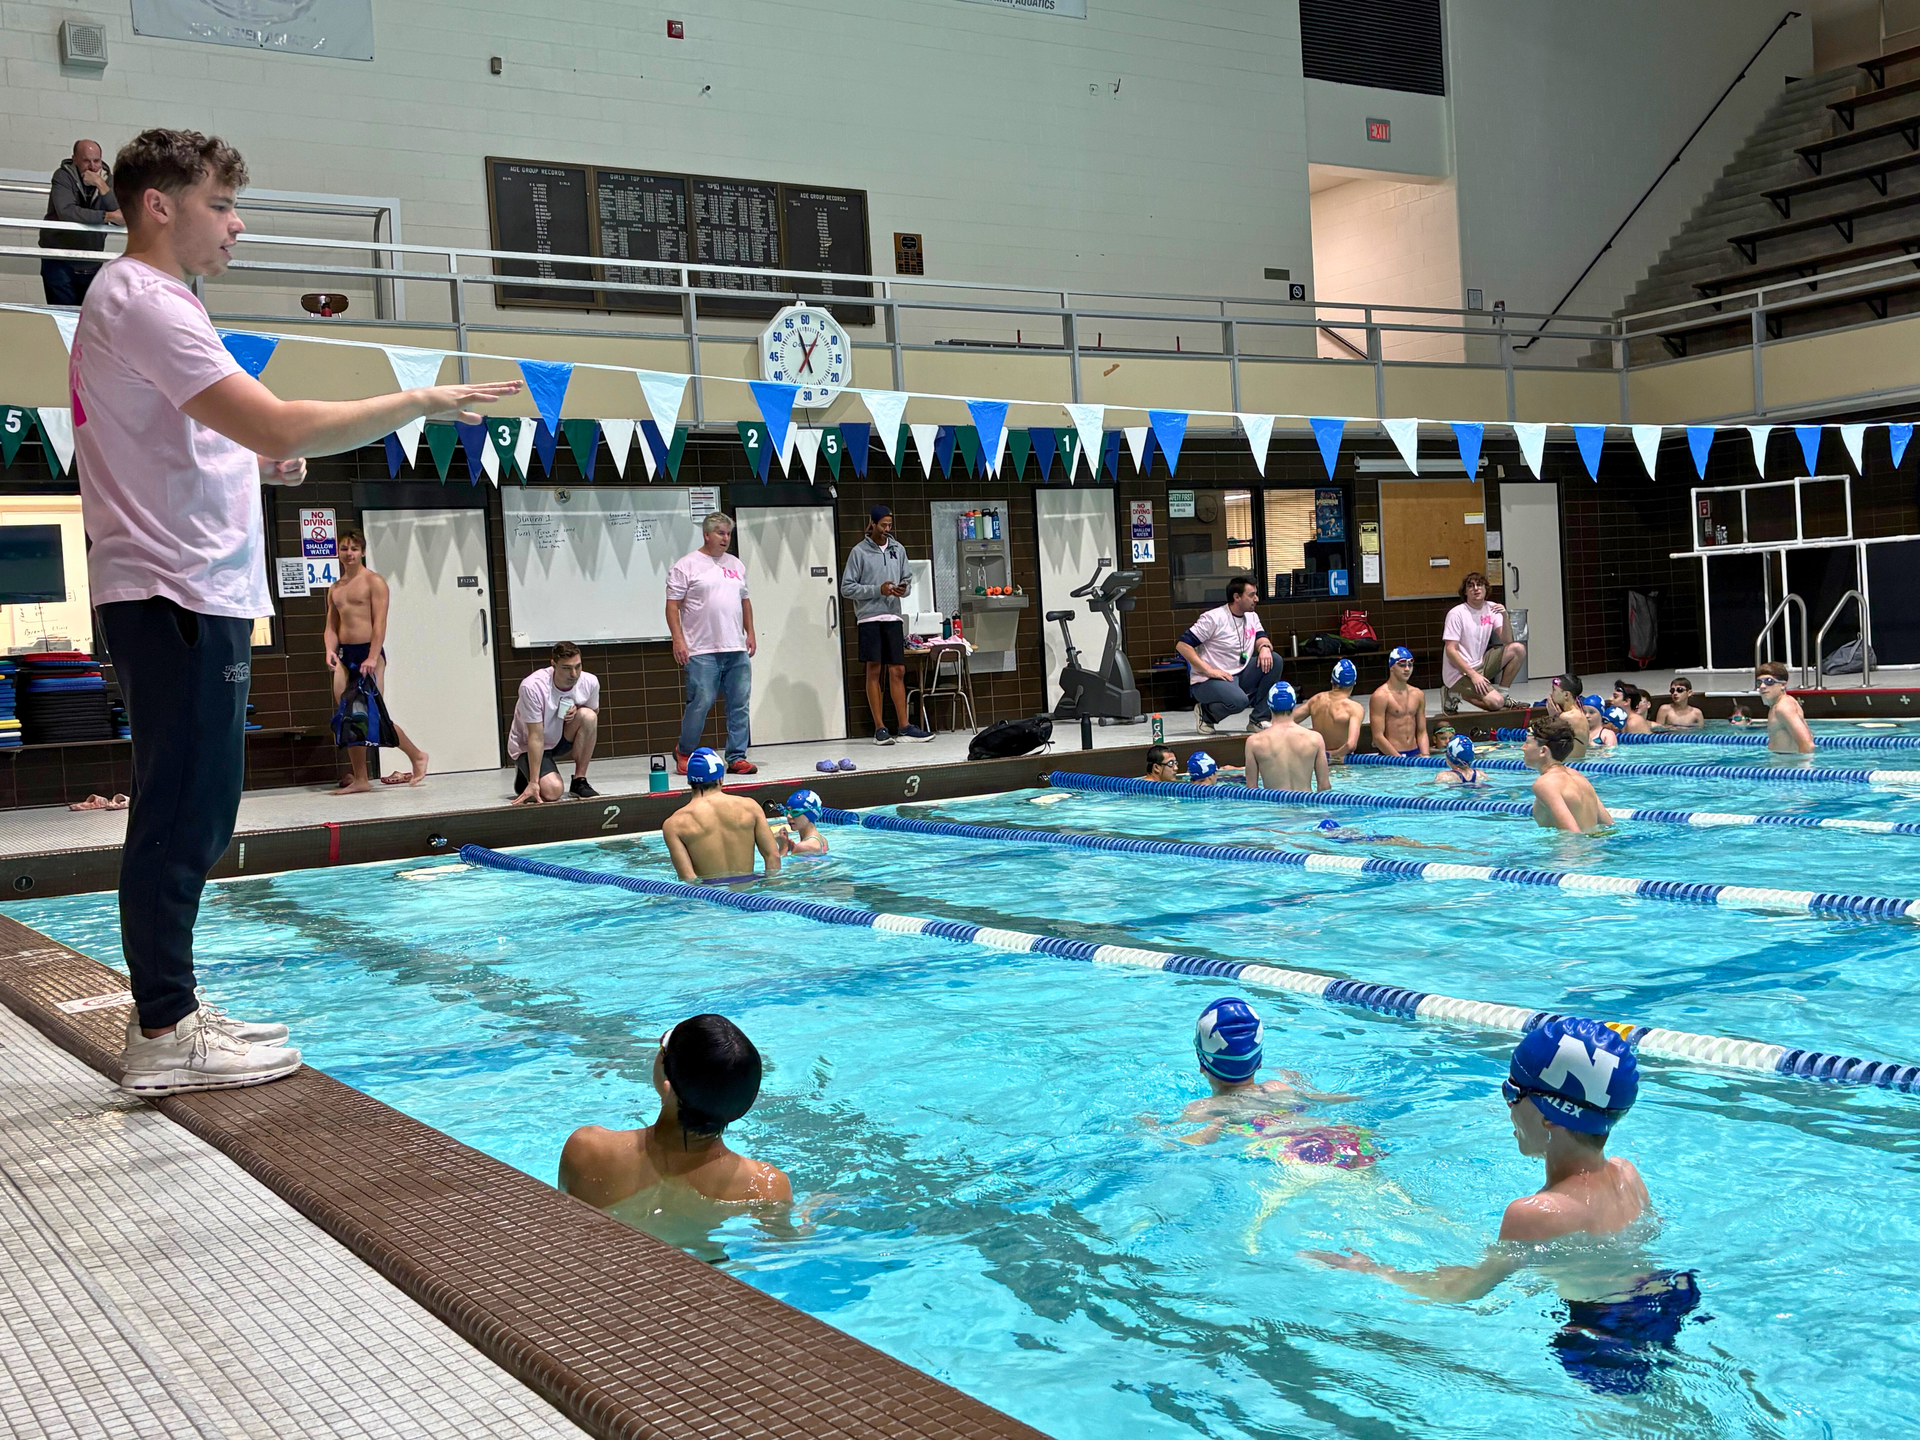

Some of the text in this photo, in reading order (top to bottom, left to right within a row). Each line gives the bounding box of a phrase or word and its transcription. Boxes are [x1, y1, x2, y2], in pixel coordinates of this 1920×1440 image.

[1369, 122, 1389, 139] EXIT
[541, 168, 565, 176] RECORDS
[785, 319, 794, 329] 55
[801, 315, 810, 325] 60
[820, 321, 825, 330] 5
[773, 332, 782, 342] 50
[831, 335, 838, 345] 10
[769, 352, 779, 362] 45
[835, 354, 842, 364] 15
[774, 371, 783, 381] 40
[831, 373, 839, 382] 20
[803, 391, 812, 401] 30
[5, 410, 22, 433] 5
[498, 425, 511, 446] 3
[747, 429, 758, 447] 2
[826, 435, 837, 453] 5
[1063, 435, 1070, 452] 1
[890, 551, 897, 559] N
[1134, 544, 1139, 559] 3
[1143, 543, 1150, 558] 4
[307, 563, 315, 584] 3
[322, 563, 332, 583] 4
[904, 775, 920, 797] 3
[601, 805, 620, 829] 2
[1539, 1034, 1620, 1109] N
